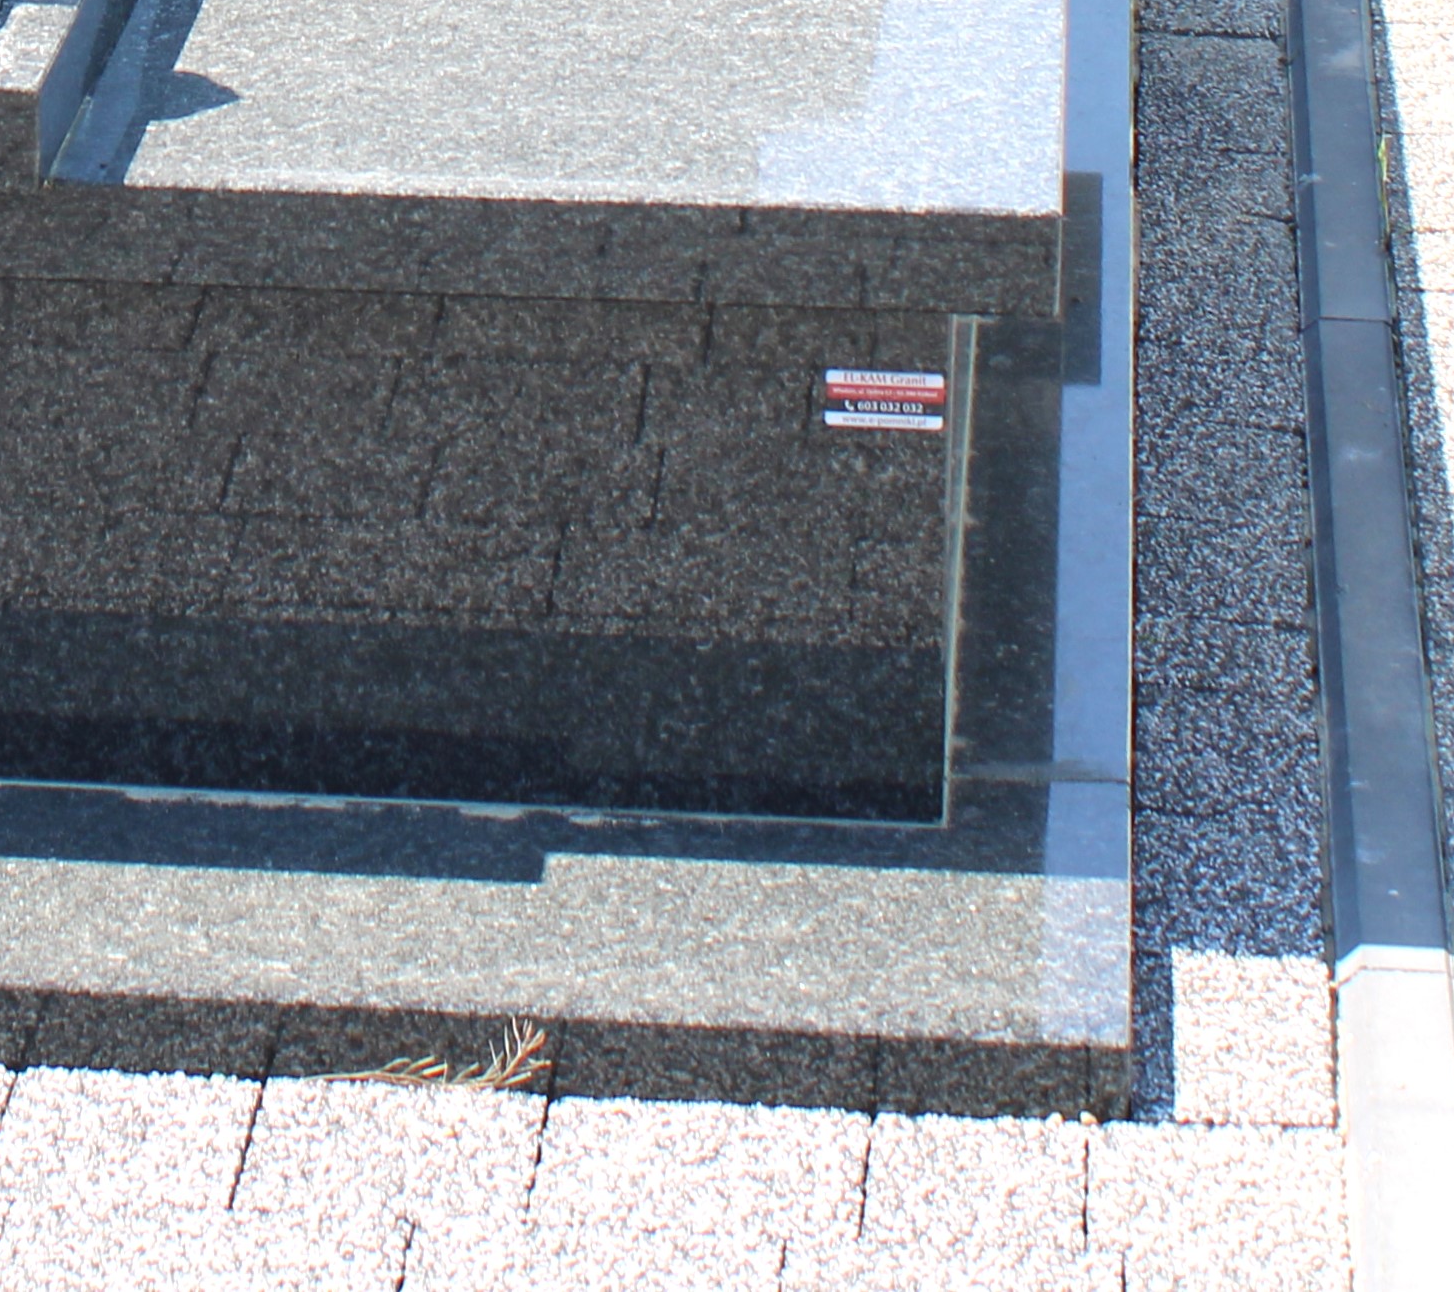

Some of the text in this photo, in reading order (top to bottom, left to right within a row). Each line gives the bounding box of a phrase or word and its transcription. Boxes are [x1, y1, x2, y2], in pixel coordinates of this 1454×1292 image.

[843, 372, 927, 386] EL-KAM Granit
[857, 400, 924, 414] 603 032 032
